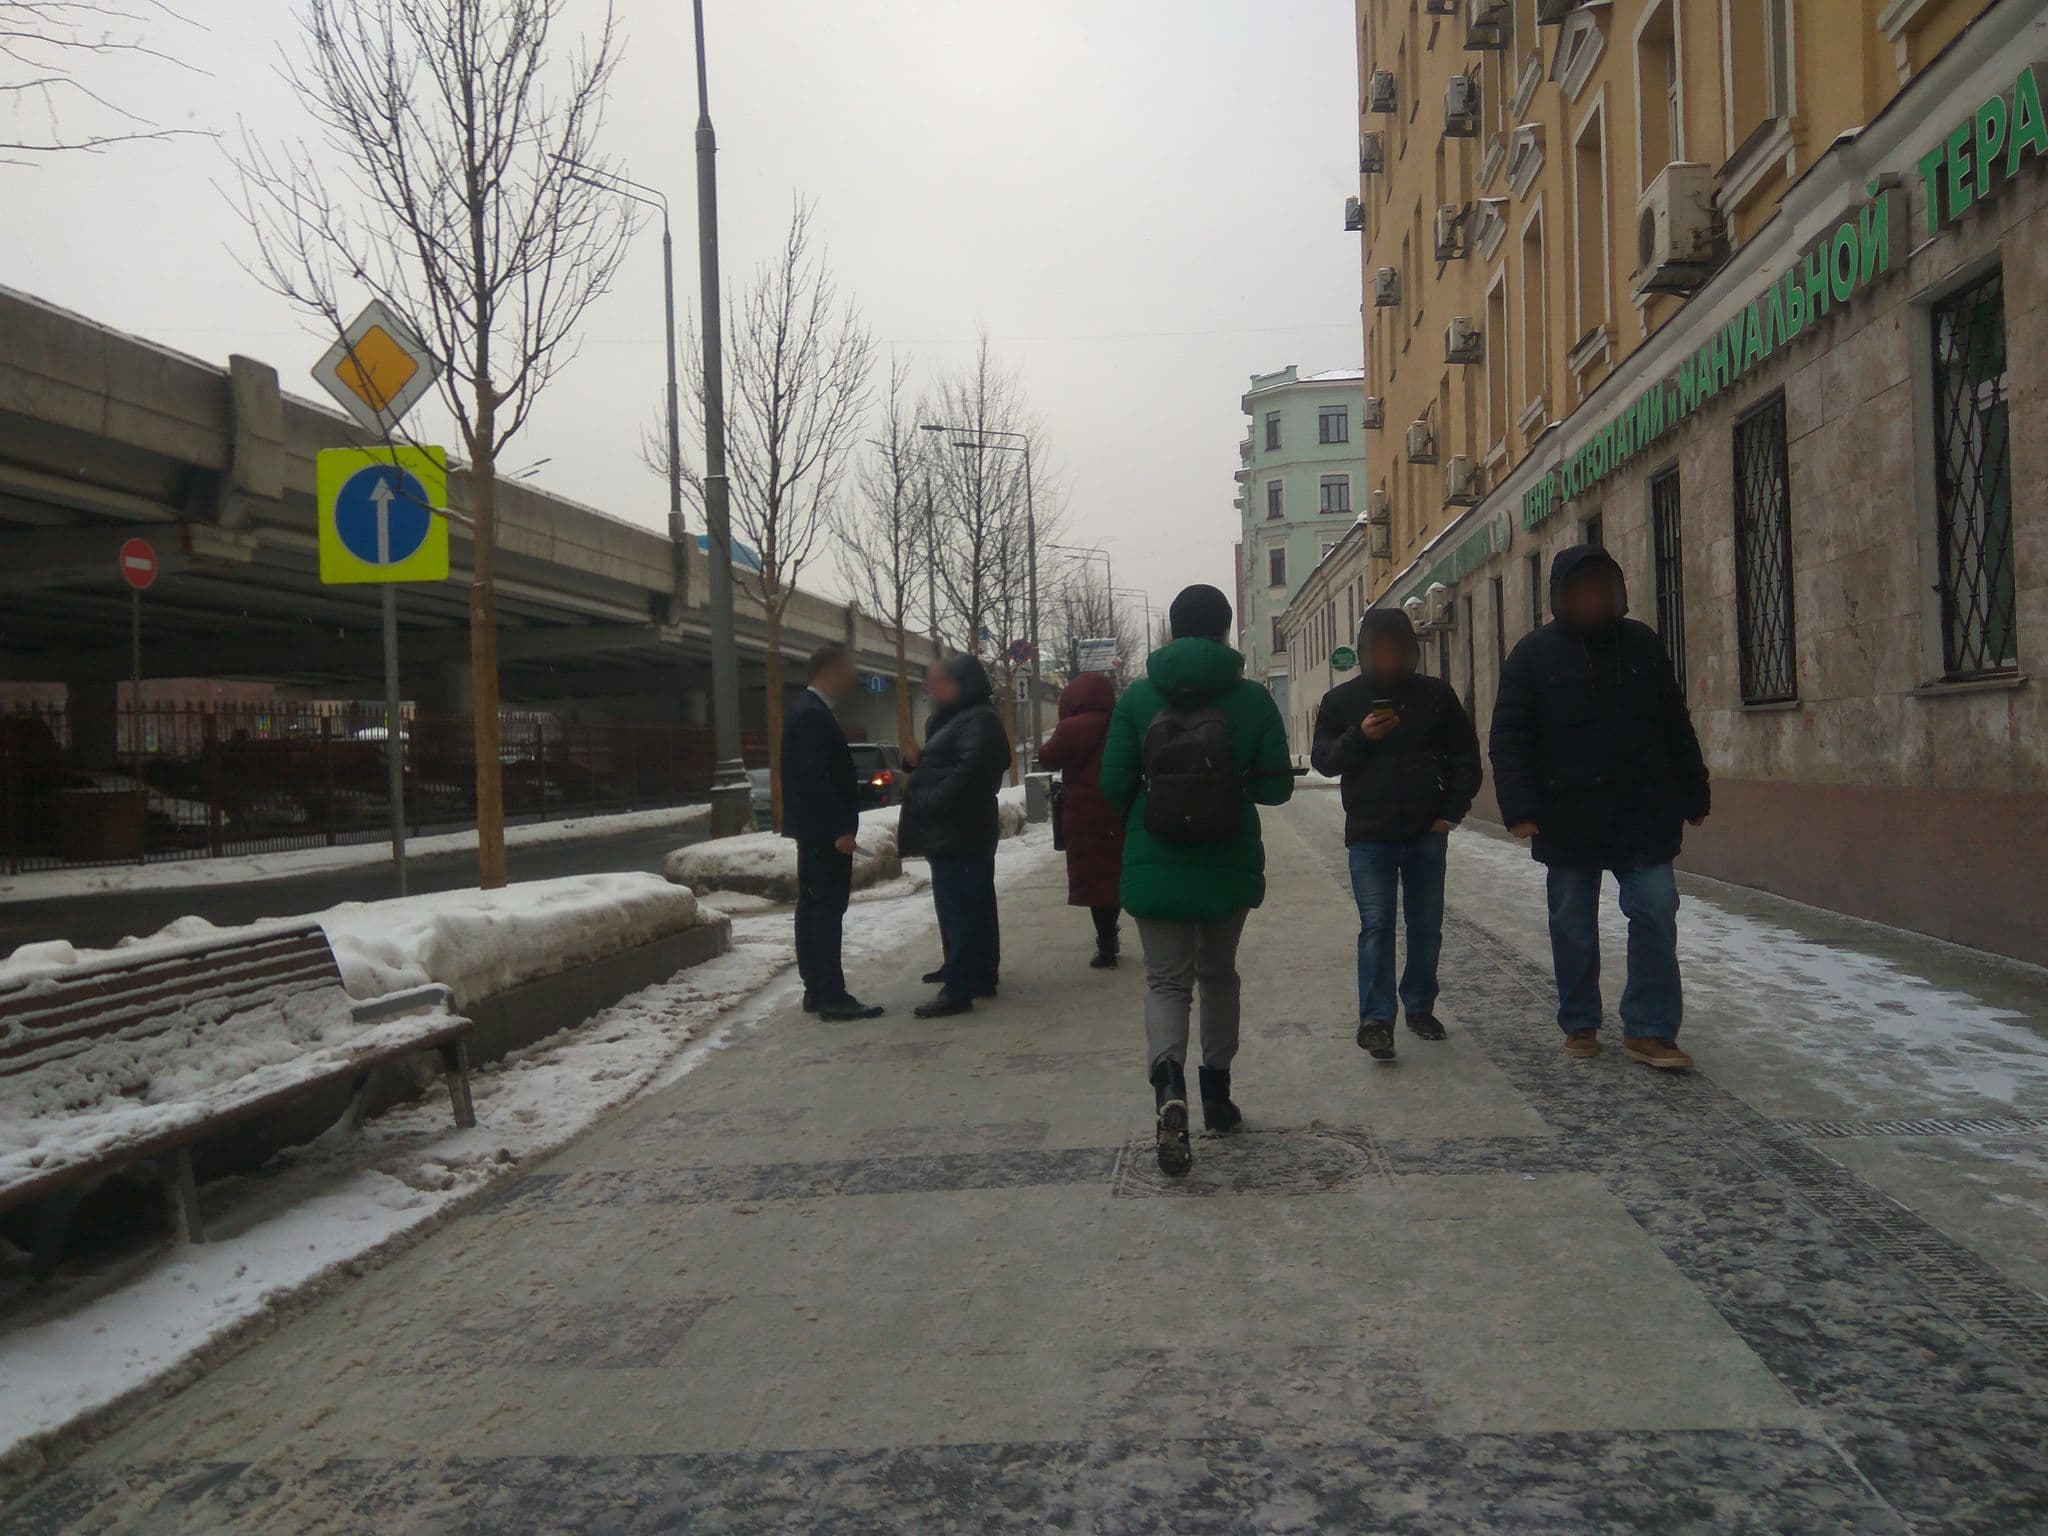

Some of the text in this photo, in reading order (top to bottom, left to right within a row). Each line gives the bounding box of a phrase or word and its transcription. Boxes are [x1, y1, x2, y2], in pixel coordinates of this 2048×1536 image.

[1521, 470, 1555, 531] ЦЕНТР
[1561, 379, 1664, 503] ОСТЕОПАТИИ
[1679, 176, 1889, 418] МАНУАЛЬНОЙ
[1919, 66, 2048, 238] ТЕРА
